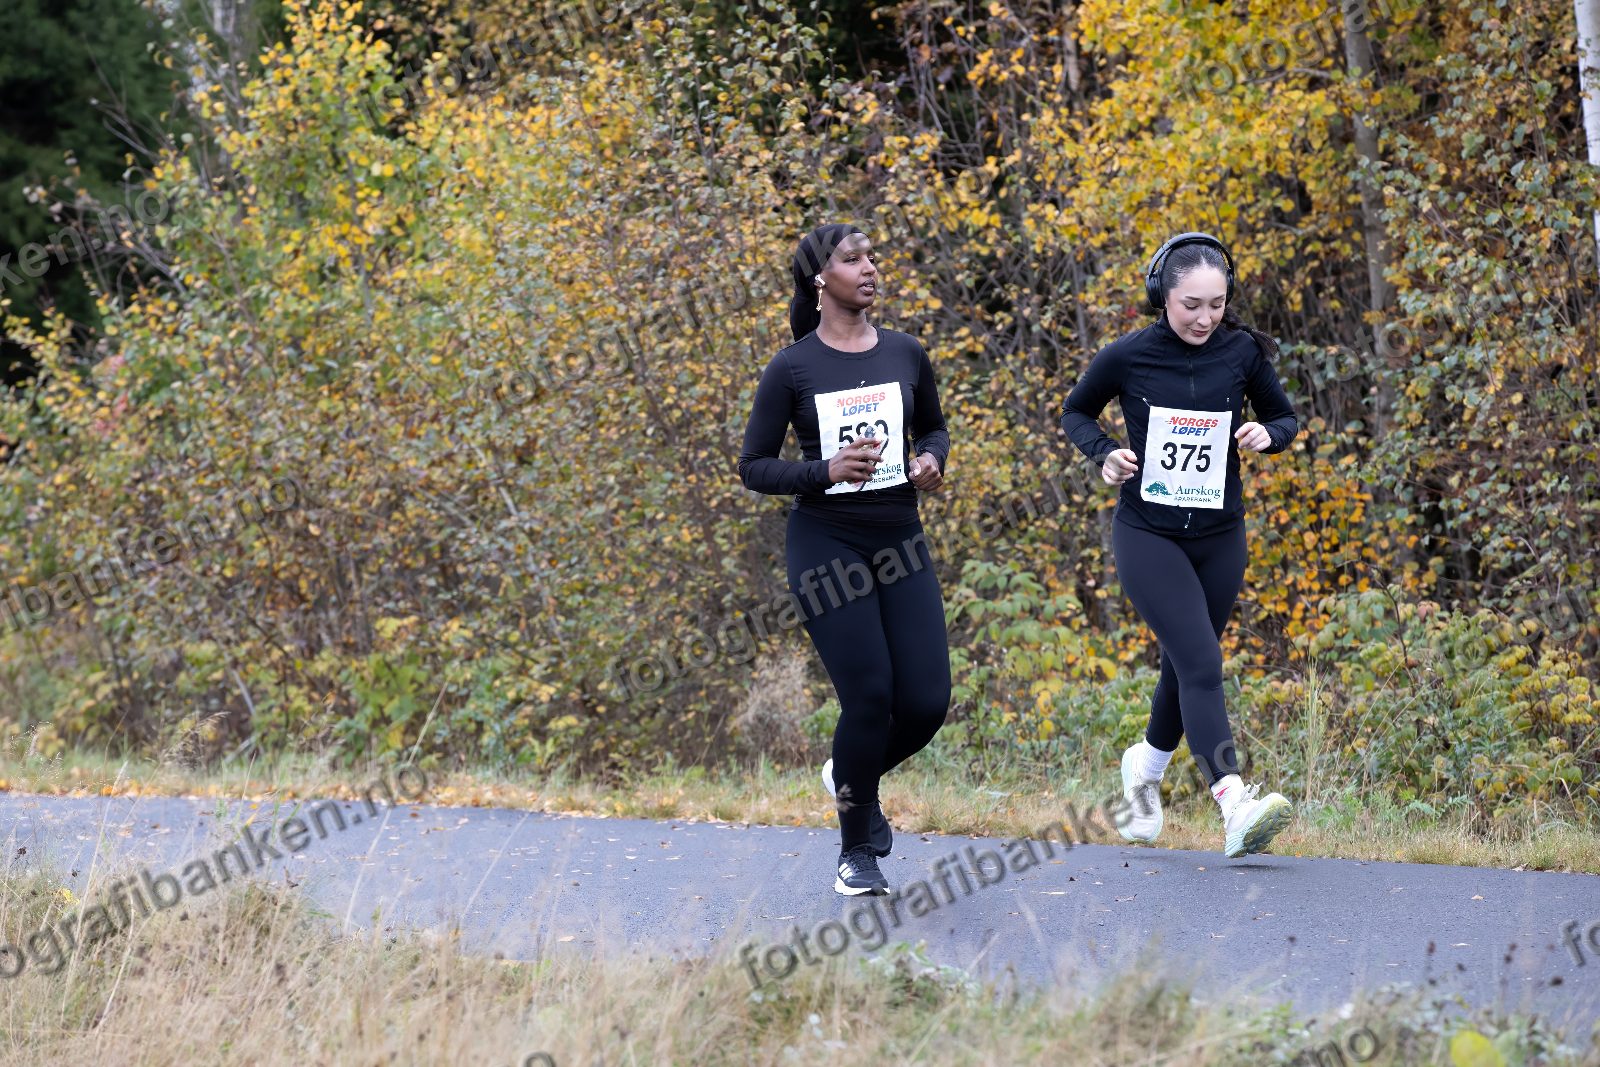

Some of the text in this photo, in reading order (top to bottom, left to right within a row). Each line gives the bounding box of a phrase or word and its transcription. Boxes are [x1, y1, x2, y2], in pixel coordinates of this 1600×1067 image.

[837, 392, 886, 407] NORGES
[843, 402, 879, 416] LØPET
[1167, 416, 1218, 428] NORGES
[1172, 426, 1210, 436] LØPET
[1161, 442, 1211, 473] 375
[870, 463, 902, 477] rskog
[1175, 485, 1221, 499] Aurskog
